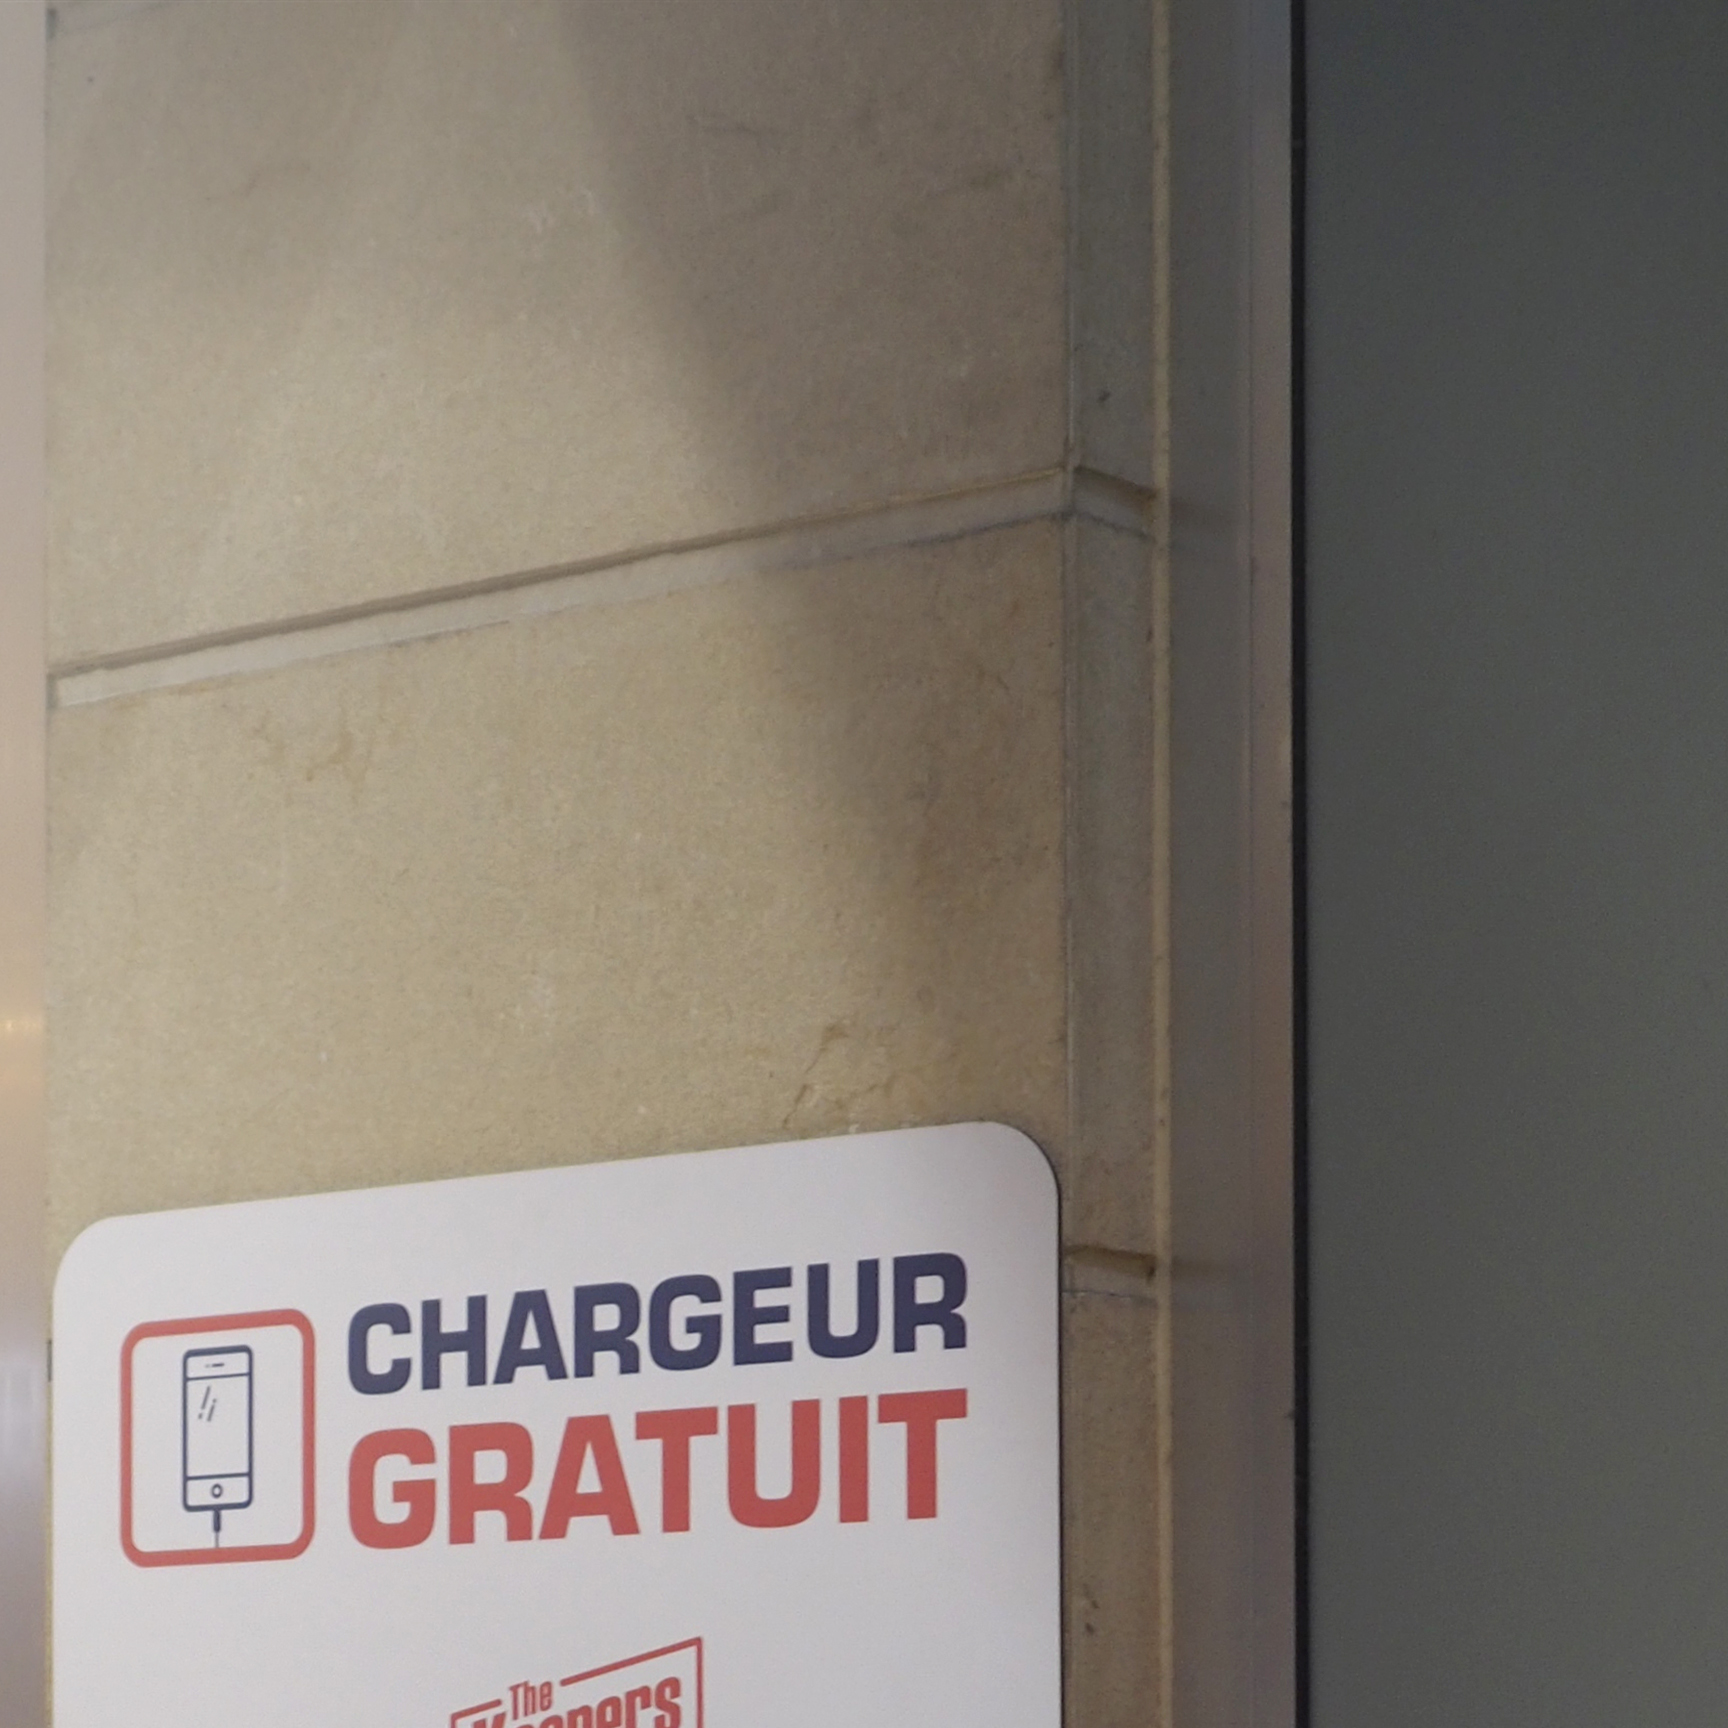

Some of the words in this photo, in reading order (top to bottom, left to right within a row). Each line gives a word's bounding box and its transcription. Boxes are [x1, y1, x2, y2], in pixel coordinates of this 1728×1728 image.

[348, 1252, 967, 1396] CHARGEUR
[348, 1388, 968, 1550] GRATUIT
[509, 1680, 553, 1721] The
